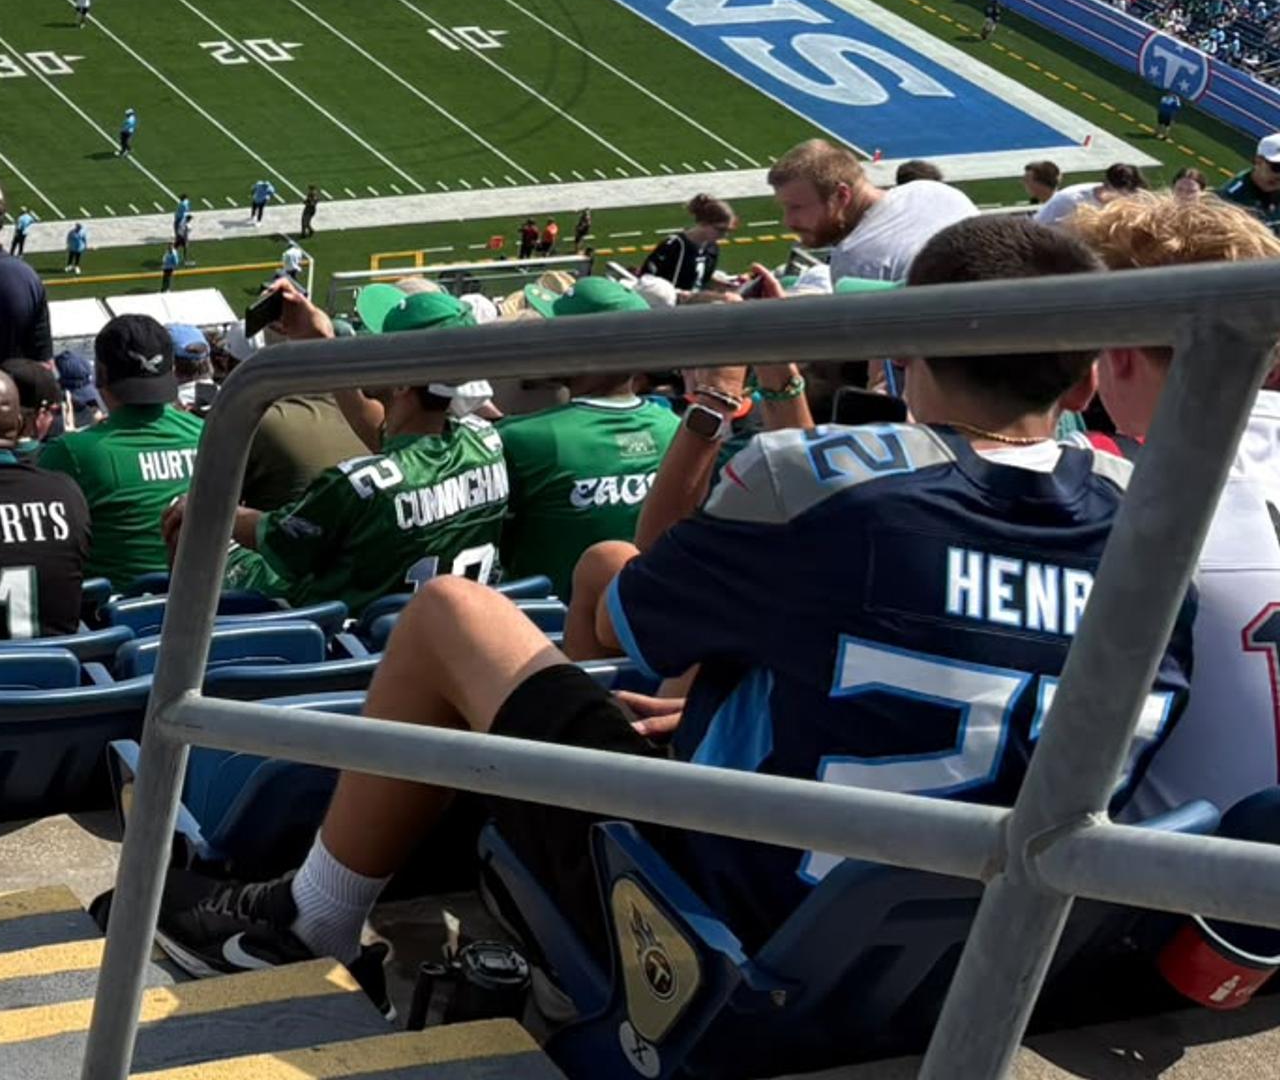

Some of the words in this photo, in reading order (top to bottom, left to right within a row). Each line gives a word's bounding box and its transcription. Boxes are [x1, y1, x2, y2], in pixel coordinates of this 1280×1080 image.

[198, 37, 294, 64] 20
[427, 26, 502, 51] 10
[139, 449, 198, 481] HURT
[947, 547, 1096, 634] HENR
